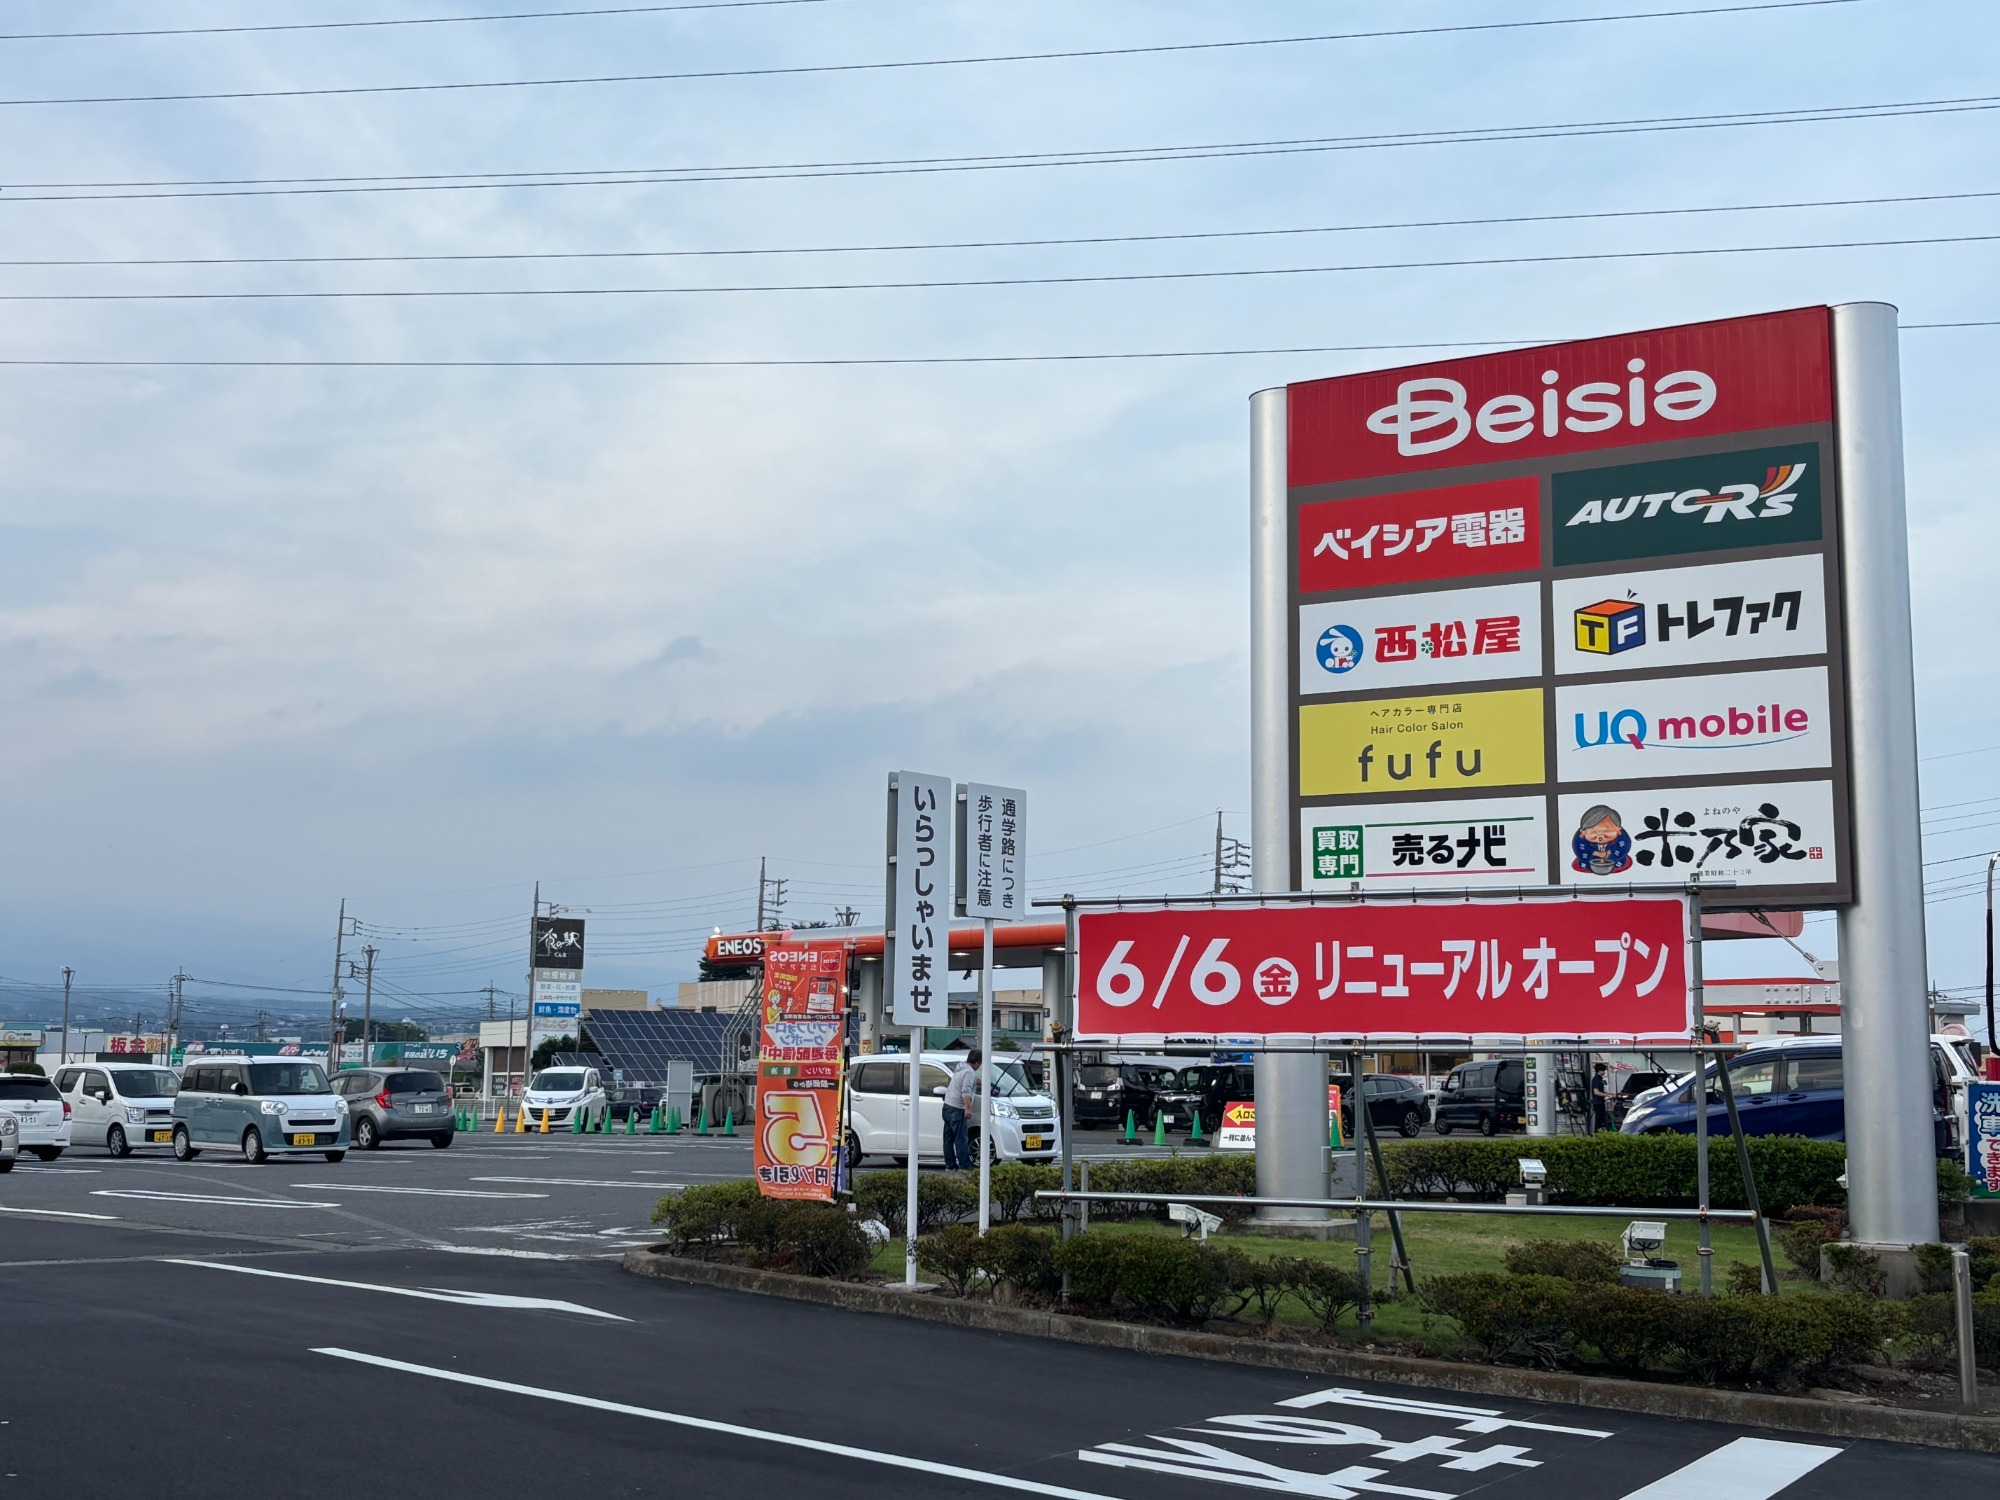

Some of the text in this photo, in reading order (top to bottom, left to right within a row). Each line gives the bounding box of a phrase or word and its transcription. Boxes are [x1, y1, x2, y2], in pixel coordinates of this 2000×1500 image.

[1366, 357, 1717, 457] Beisia
[1313, 507, 1526, 560] ベイシア電器
[1374, 615, 1521, 664] 西松屋
[1657, 590, 1803, 642] トレファク
[1370, 703, 1463, 718] ヘアカラー専門店
[1370, 720, 1464, 735] Hair Color Salon
[1574, 703, 1809, 750] UQ mobile
[1357, 739, 1482, 783] fufu
[1702, 805, 1742, 816] よねのや
[976, 794, 993, 907] 歩行者に注意
[1001, 798, 1017, 910] 通学路につき
[1317, 830, 1360, 851] 買取
[1391, 824, 1507, 868] 売るナビ
[1634, 802, 1808, 869] 米乃家
[1317, 854, 1359, 876] 専門
[910, 785, 937, 1013] いらっしゃいませ
[717, 937, 762, 956] ENEOS
[1096, 933, 1241, 1010] 6/6
